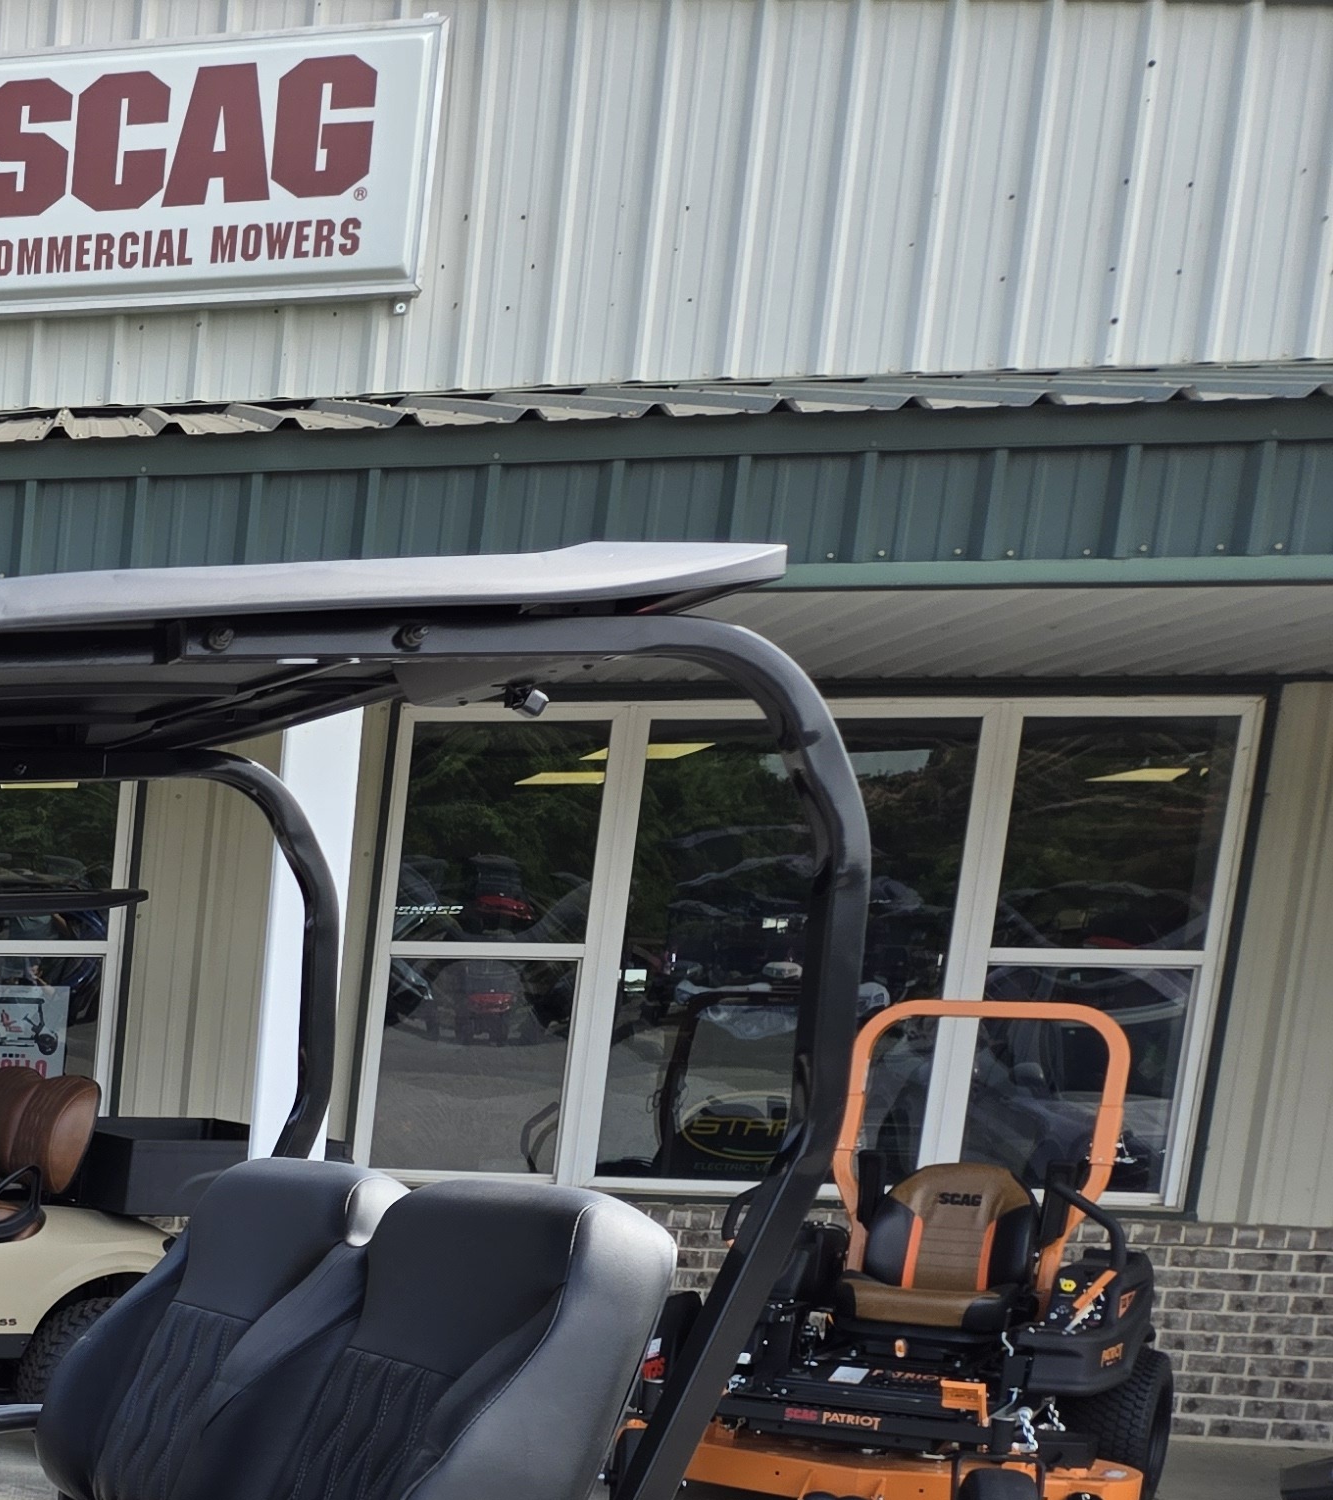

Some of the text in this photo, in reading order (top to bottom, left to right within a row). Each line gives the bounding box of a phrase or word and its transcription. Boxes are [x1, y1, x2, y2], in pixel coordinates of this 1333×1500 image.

[208, 218, 363, 262] MOWERS
[938, 1192, 983, 1207] SCAG
[821, 1411, 882, 1431] PATRIOT
